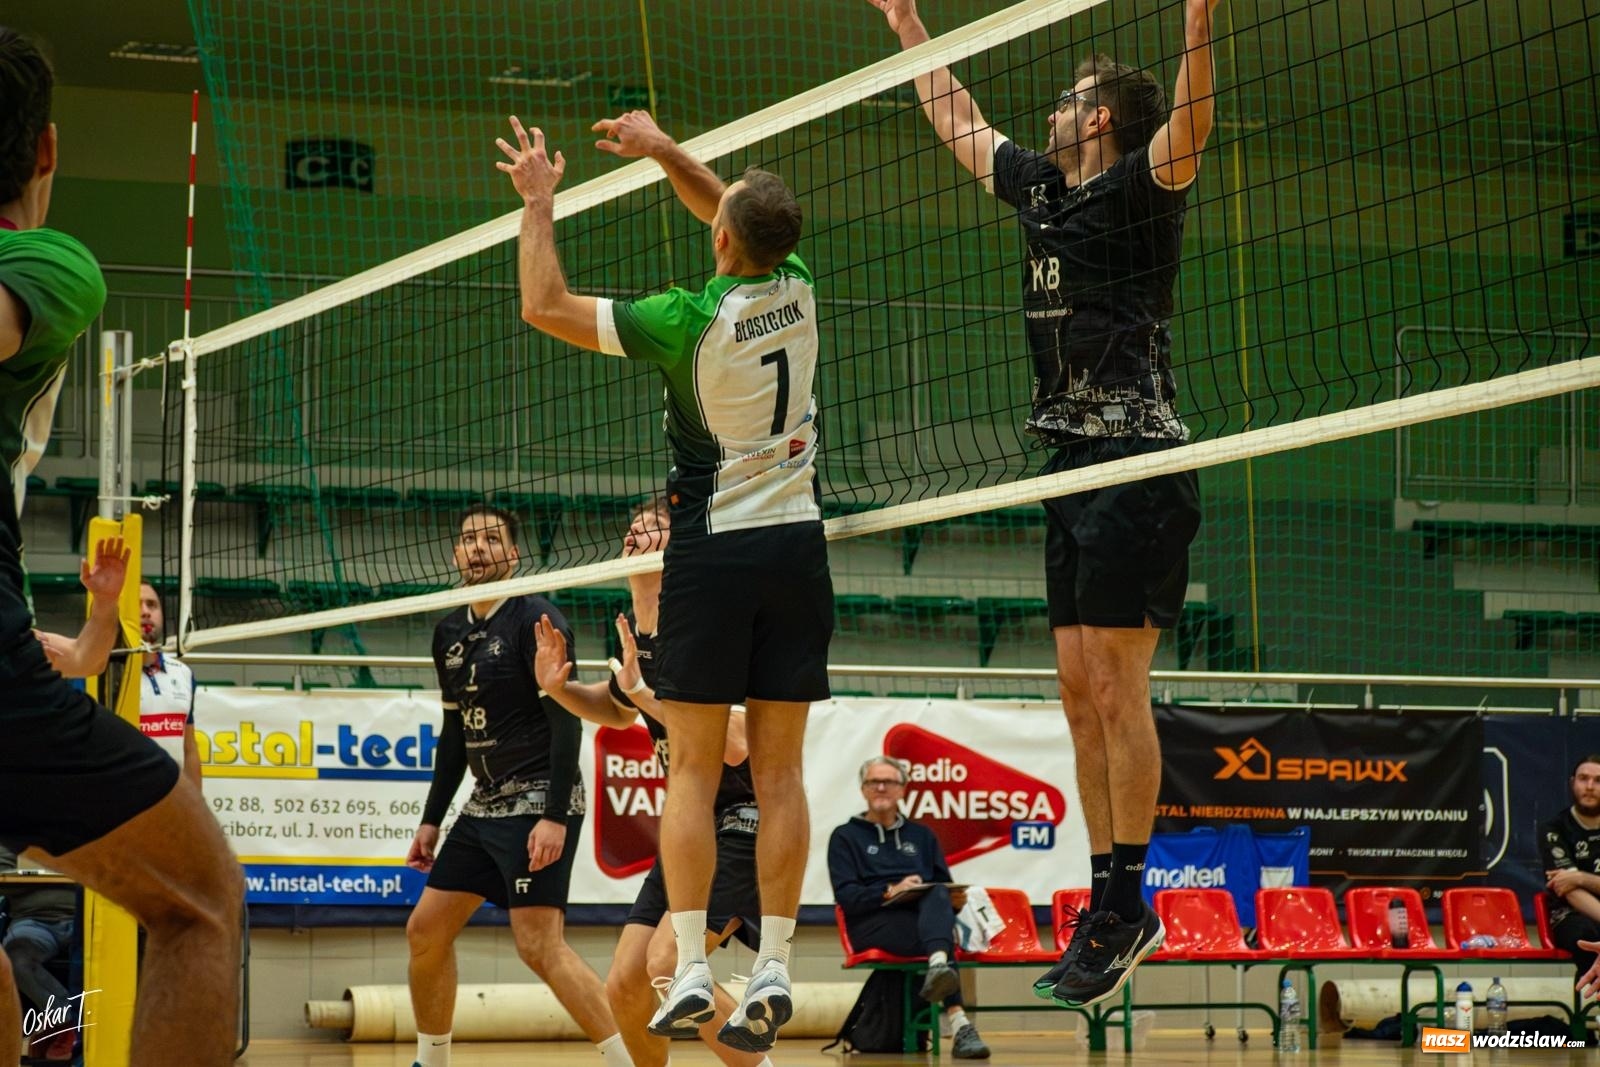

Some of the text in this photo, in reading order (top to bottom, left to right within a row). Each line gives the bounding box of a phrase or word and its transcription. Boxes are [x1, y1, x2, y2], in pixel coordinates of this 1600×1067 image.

[734, 300, 804, 343] BŁASZCZOK
[761, 347, 789, 436] 7
[140, 718, 183, 732] martes
[900, 759, 967, 783] Radio
[1276, 759, 1408, 783] SPAWX
[213, 798, 233, 812] 92
[274, 800, 304, 813] 502
[310, 800, 340, 814] 632
[390, 802, 421, 815] 606
[900, 791, 1055, 820] VANESSA
[1190, 806, 1286, 819] NIERDZEWNA
[1287, 808, 1302, 820] W
[1304, 808, 1400, 821] NAJLEPSZYM
[1402, 809, 1468, 822] WYDANIU
[222, 821, 277, 839] cibórz,
[324, 826, 354, 839] von
[1017, 827, 1049, 846] FM
[245, 873, 402, 897] w.instal-tech.pl
[1146, 864, 1226, 888] molten
